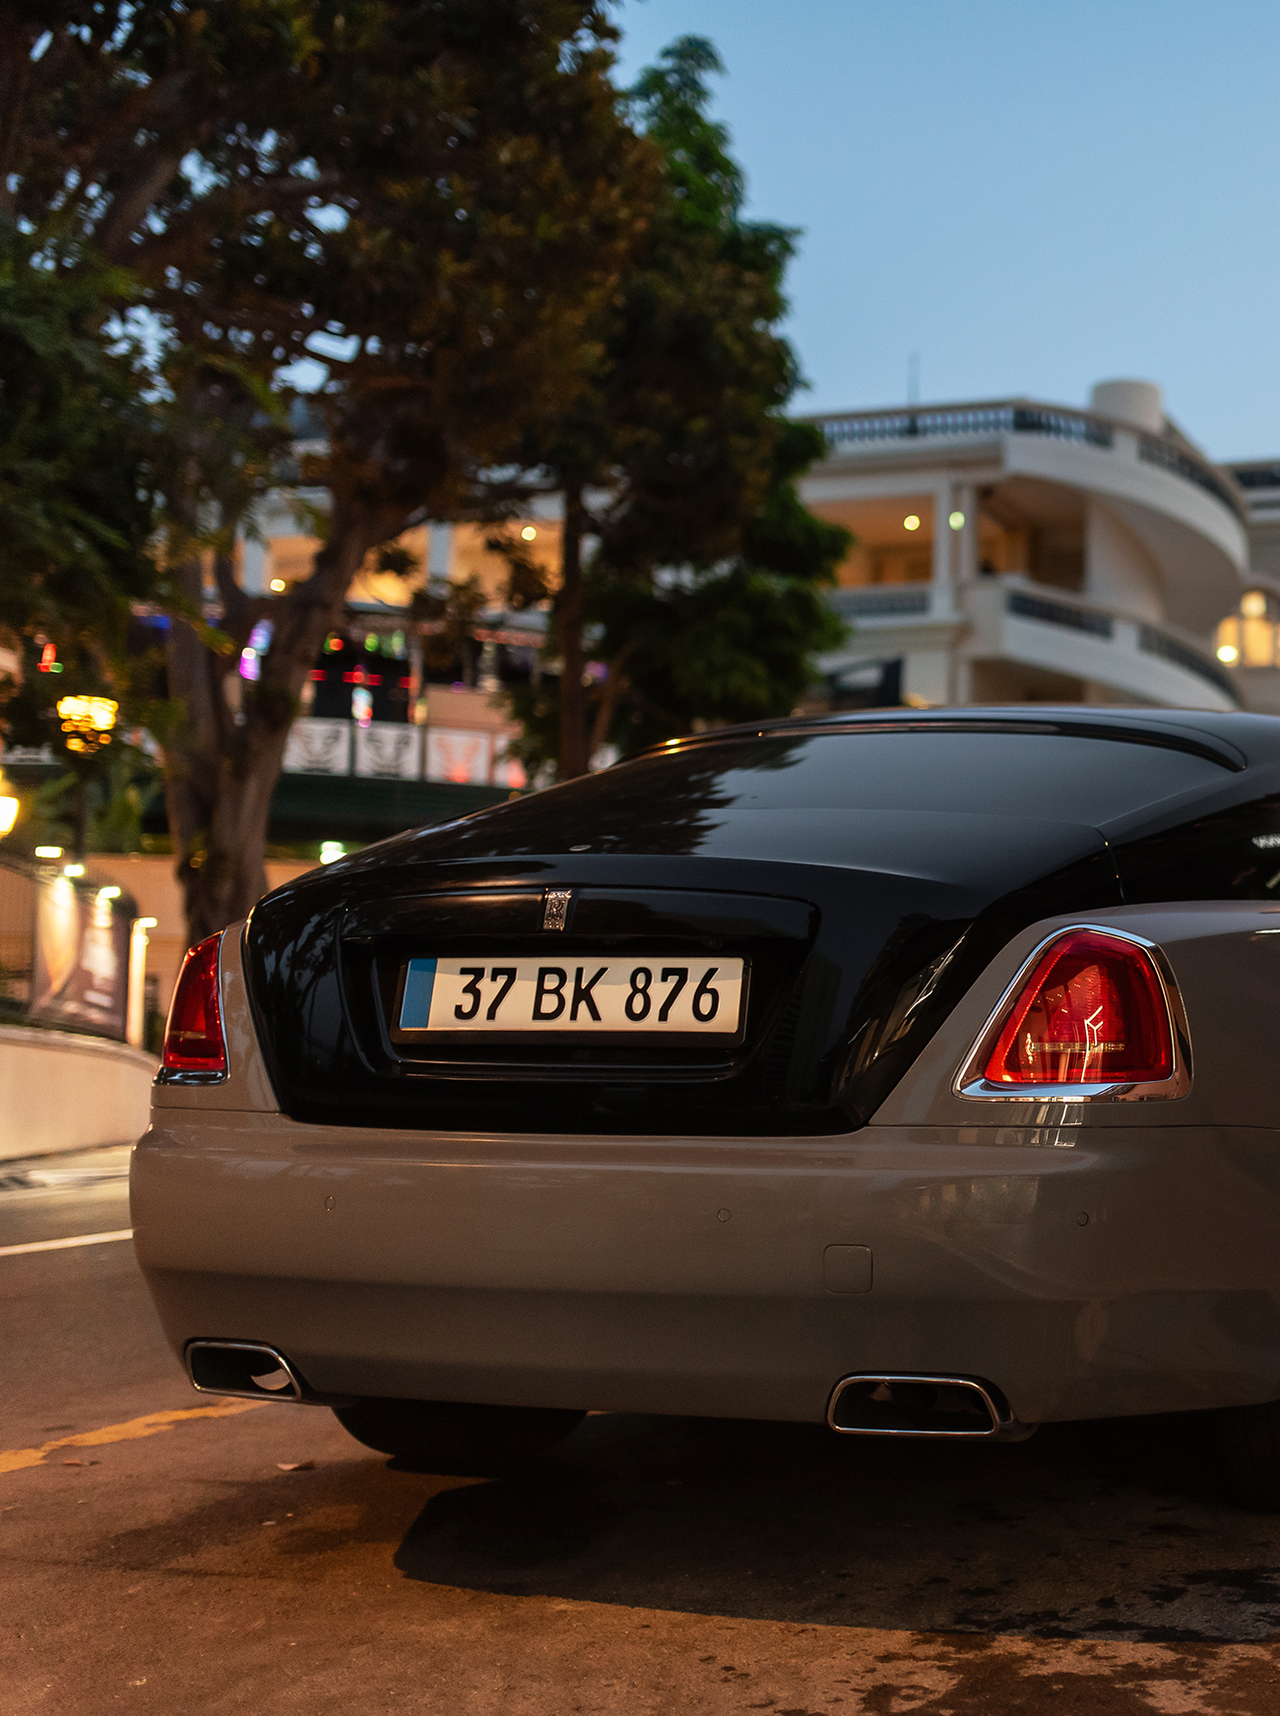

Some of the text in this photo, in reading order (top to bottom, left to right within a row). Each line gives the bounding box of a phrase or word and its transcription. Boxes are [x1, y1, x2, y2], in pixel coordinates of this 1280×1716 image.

[454, 967, 720, 1023] 37 BK 876
